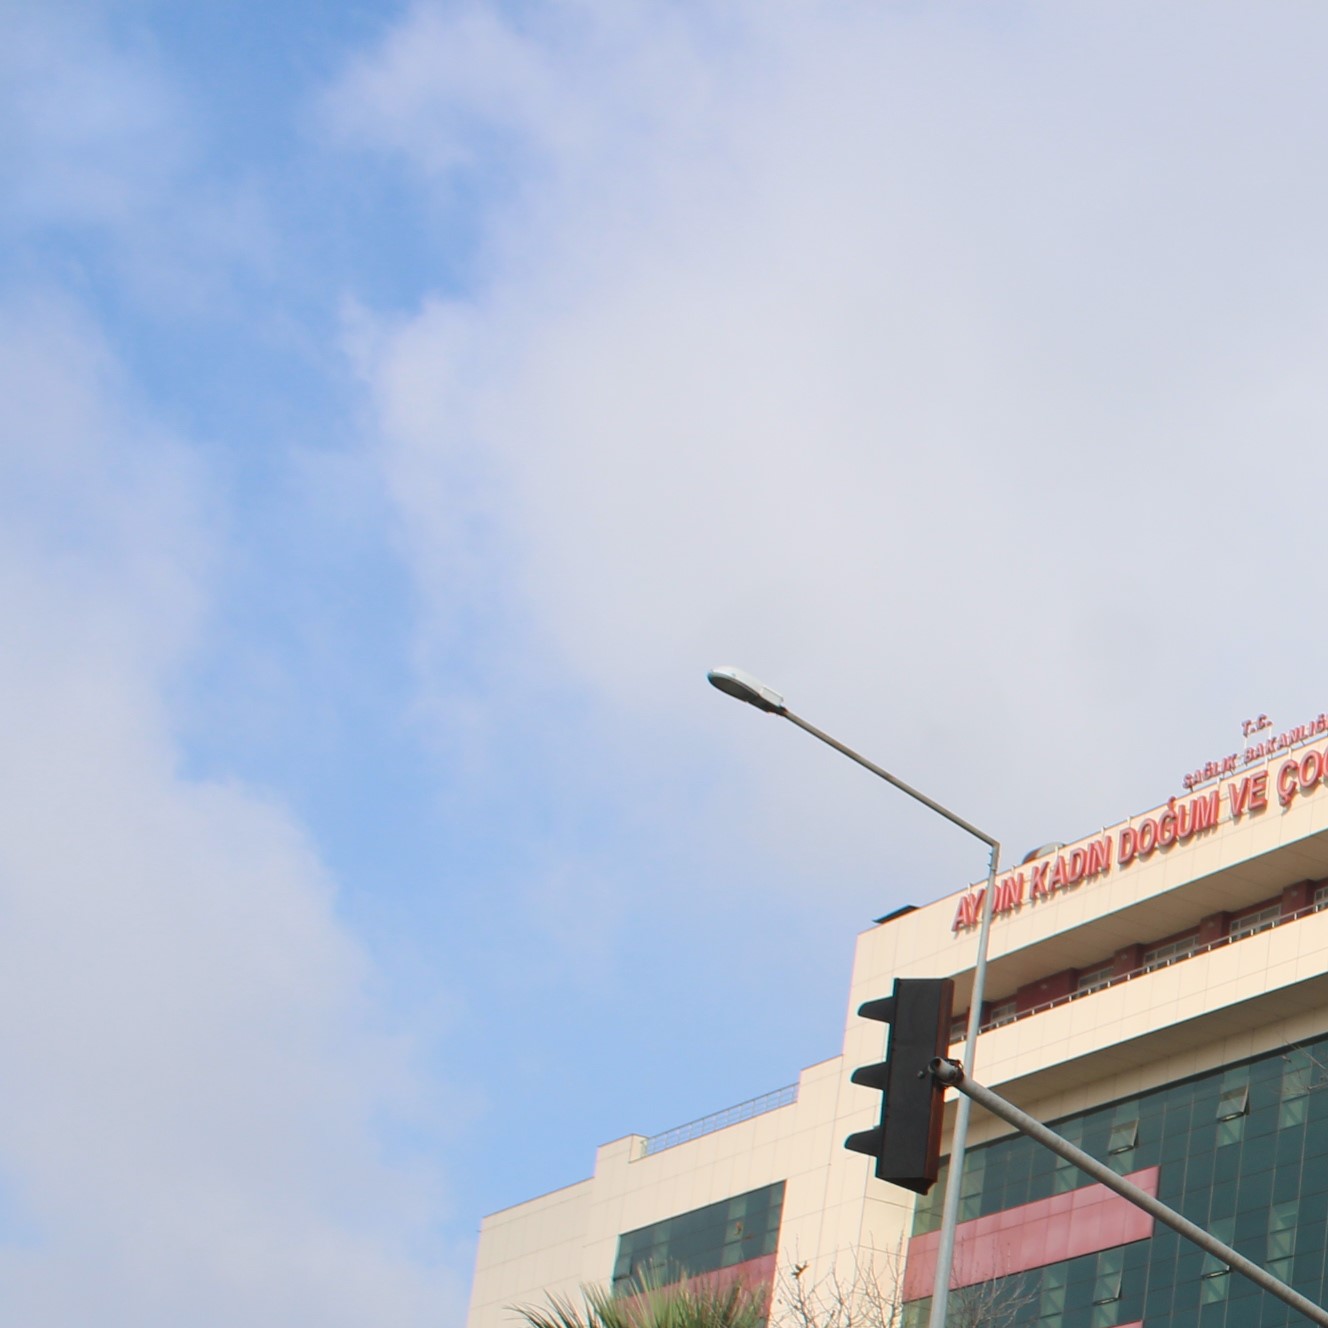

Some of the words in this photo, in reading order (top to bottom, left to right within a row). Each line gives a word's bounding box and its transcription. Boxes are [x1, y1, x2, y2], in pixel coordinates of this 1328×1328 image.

[1241, 714, 1273, 738] T.C.
[1182, 753, 1238, 789] SAĞLIK
[1029, 835, 1113, 901] KADIN
[1117, 796, 1220, 865] DOĞUM
[1228, 769, 1269, 817] VE
